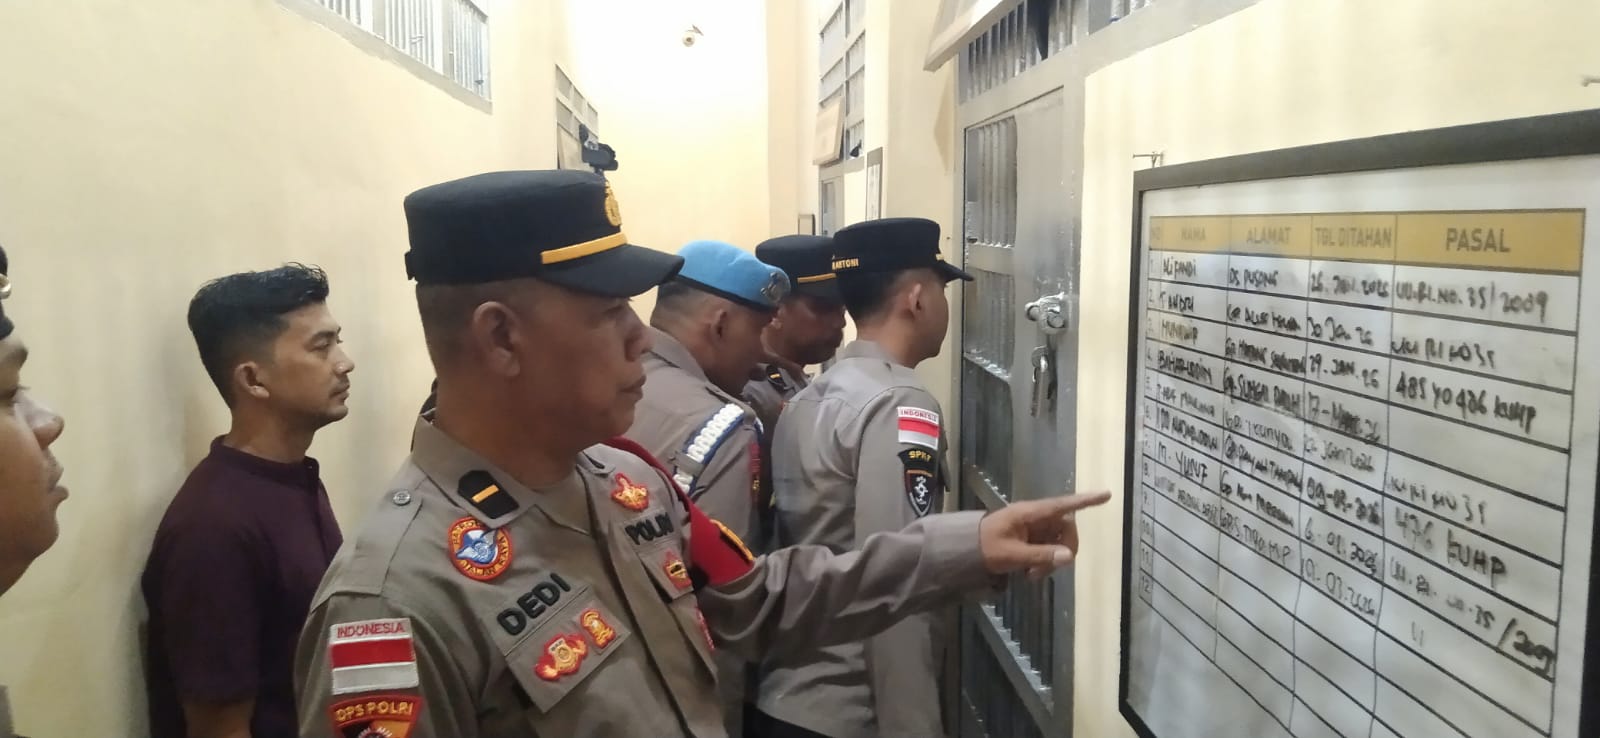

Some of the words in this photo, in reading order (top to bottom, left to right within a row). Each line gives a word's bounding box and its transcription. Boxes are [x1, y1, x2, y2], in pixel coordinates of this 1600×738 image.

[1181, 227, 1206, 242] NAMA
[1246, 227, 1291, 244] ALAMAT
[1339, 227, 1392, 248] DITAHAN
[1446, 228, 1511, 253] PASAL
[624, 512, 674, 545] POLRI
[497, 573, 571, 637] DEDI
[337, 622, 406, 638] INDONESIA
[335, 704, 365, 722] OPS
[367, 700, 414, 716] POLRI
